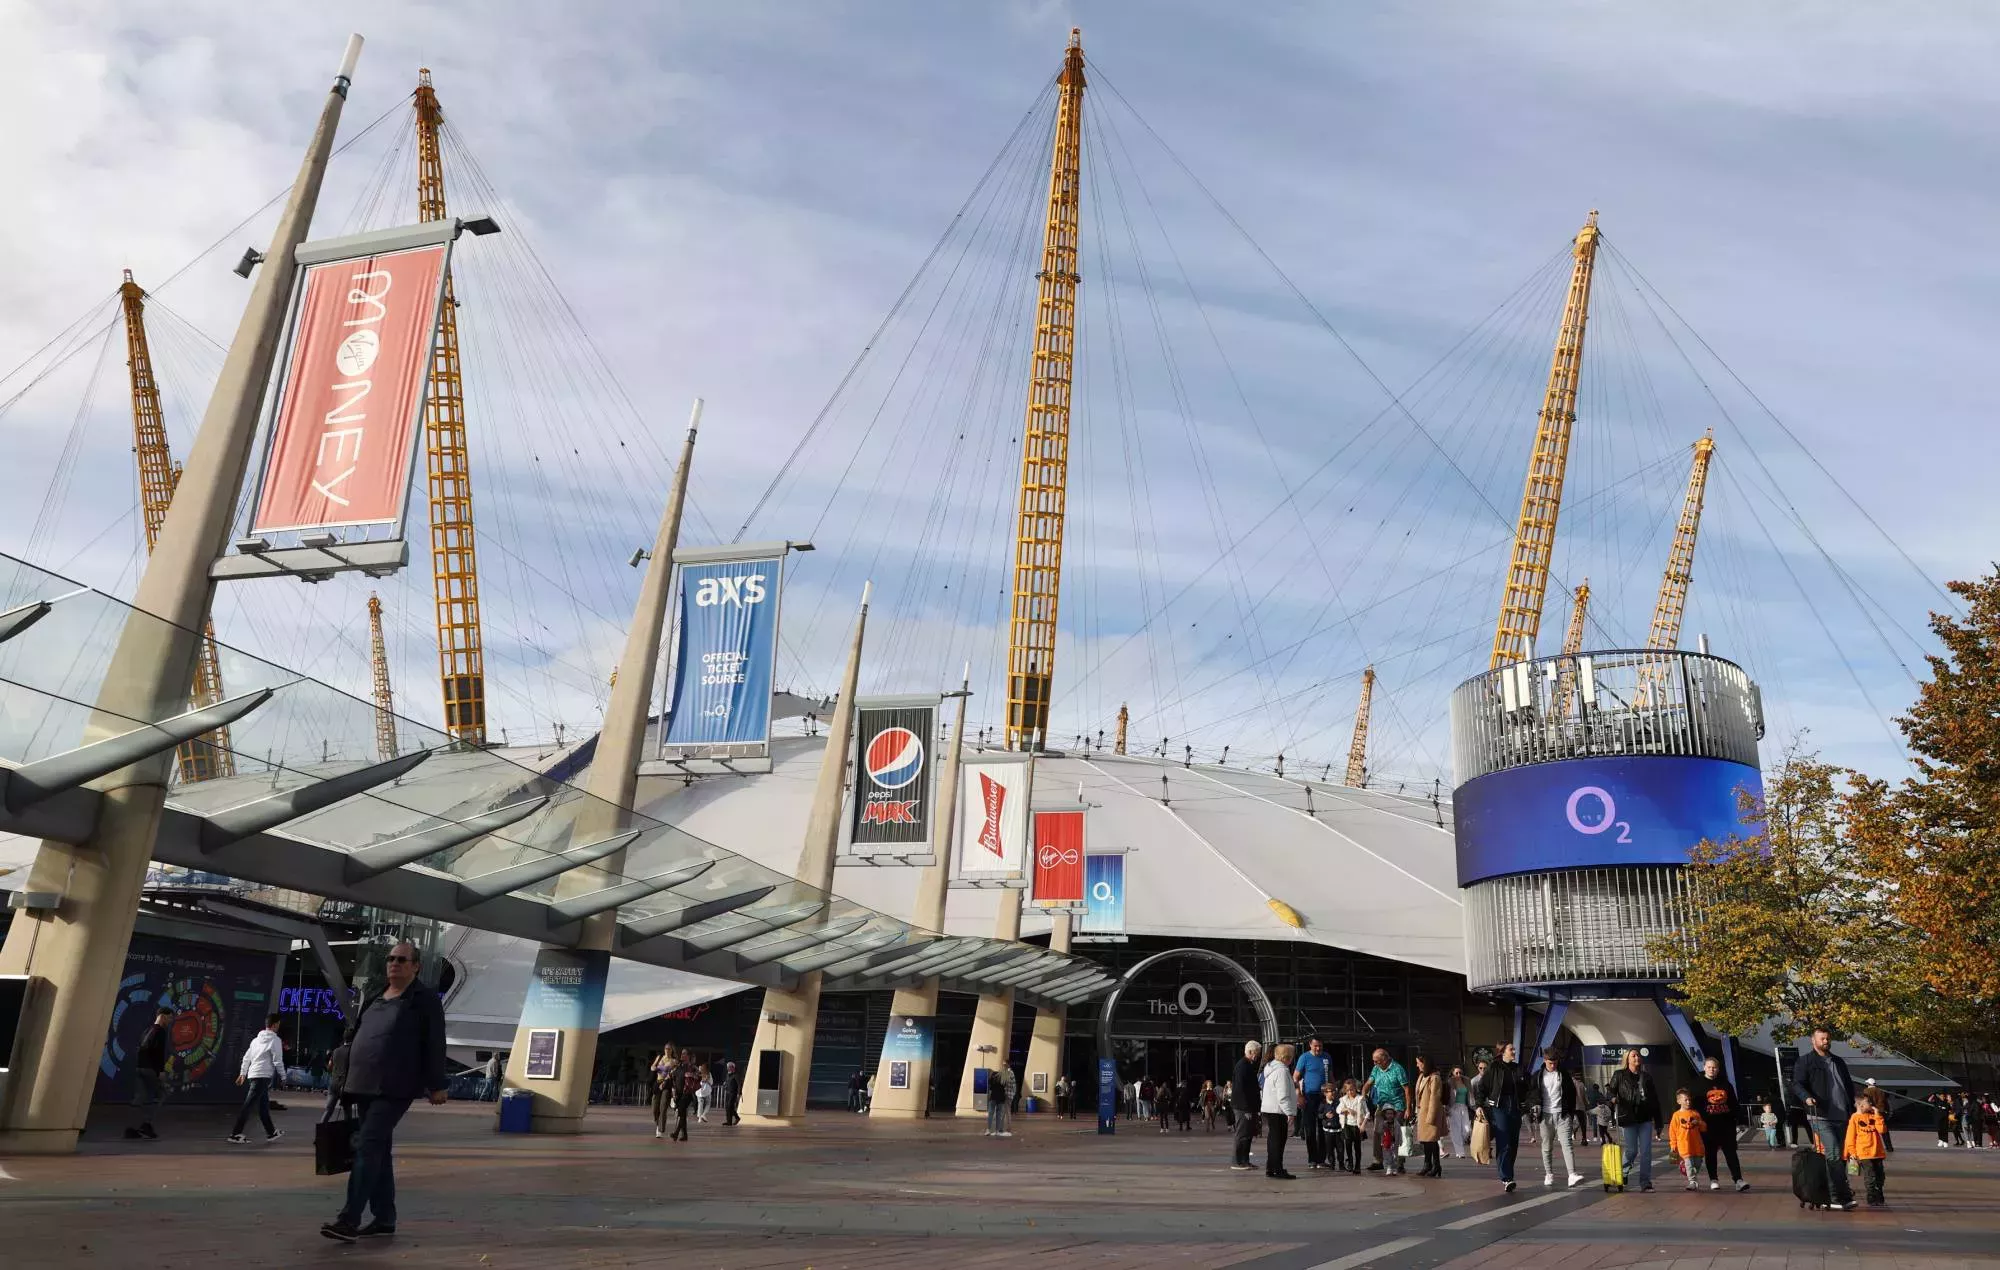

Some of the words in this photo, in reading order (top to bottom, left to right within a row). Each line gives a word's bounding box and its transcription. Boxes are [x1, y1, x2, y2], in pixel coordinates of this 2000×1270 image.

[343, 334, 375, 370] Virgin
[702, 650, 749, 664] OFFICIAL
[707, 662, 741, 674] TICKET
[701, 673, 745, 685] SOURCE
[868, 790, 893, 800] pepsi
[983, 779, 998, 853] Budweiser
[1566, 786, 1633, 844] O2
[1041, 848, 1059, 865] Virgin
[1093, 882, 1115, 905] O2
[1148, 999, 1178, 1016] The
[1178, 982, 1215, 1024] O2
[1601, 1047, 1616, 1056] Bag
